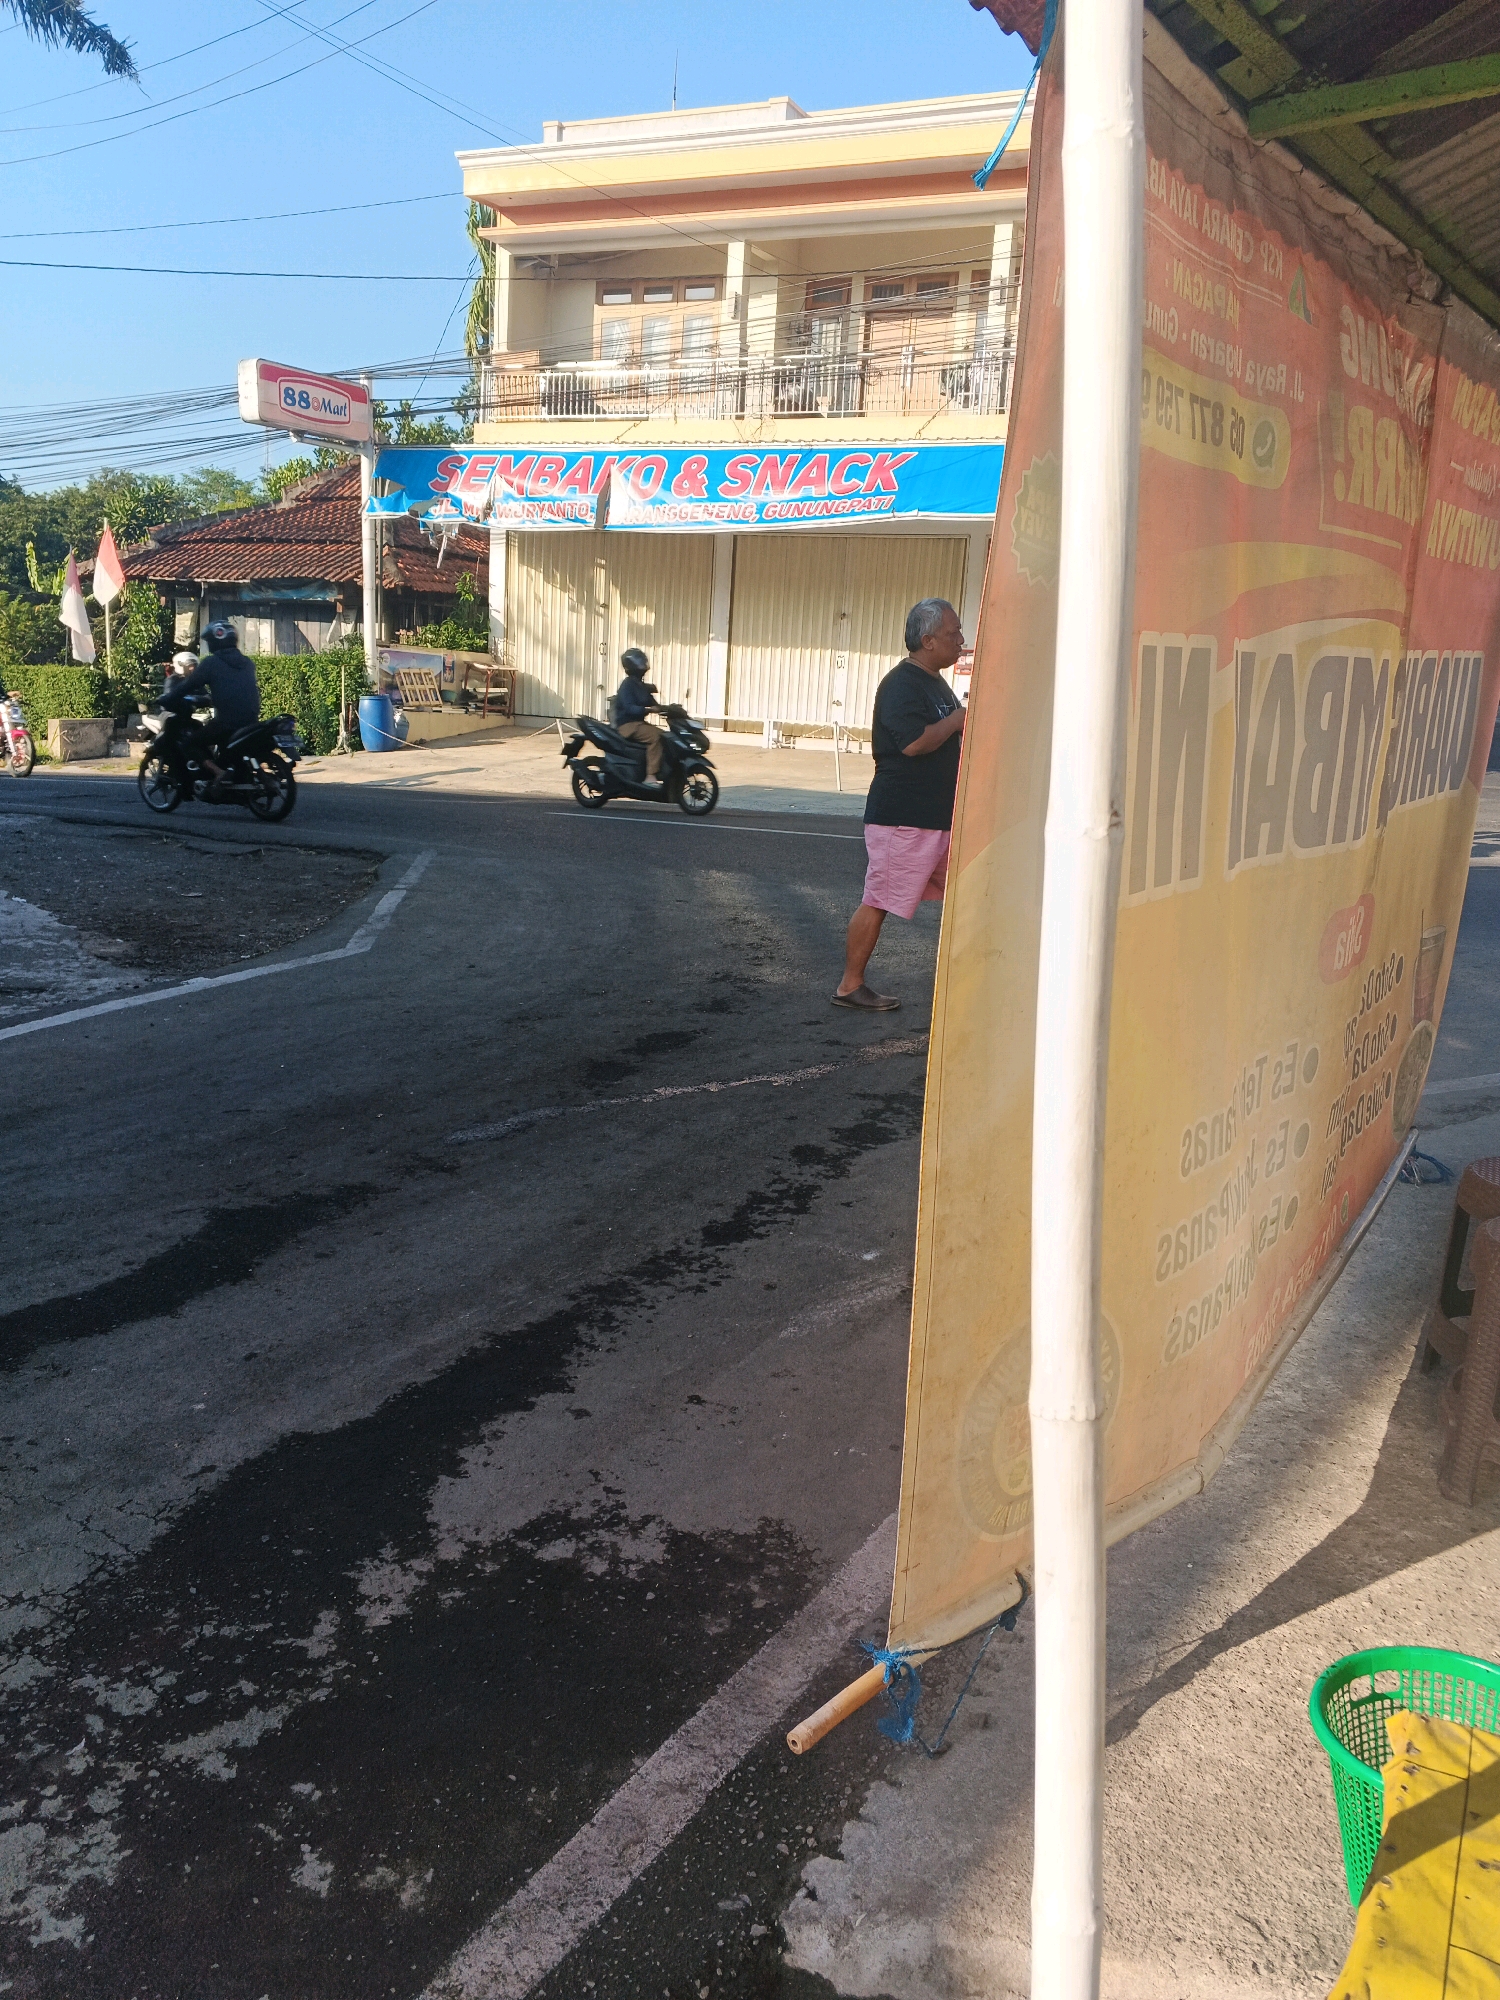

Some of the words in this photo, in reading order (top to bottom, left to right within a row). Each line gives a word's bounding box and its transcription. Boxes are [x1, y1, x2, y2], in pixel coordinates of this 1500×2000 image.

[428, 454, 668, 501] SEMBAKO
[671, 453, 709, 499] &
[717, 450, 918, 499] SNACK
[761, 494, 896, 520] GUNUNGPATI
